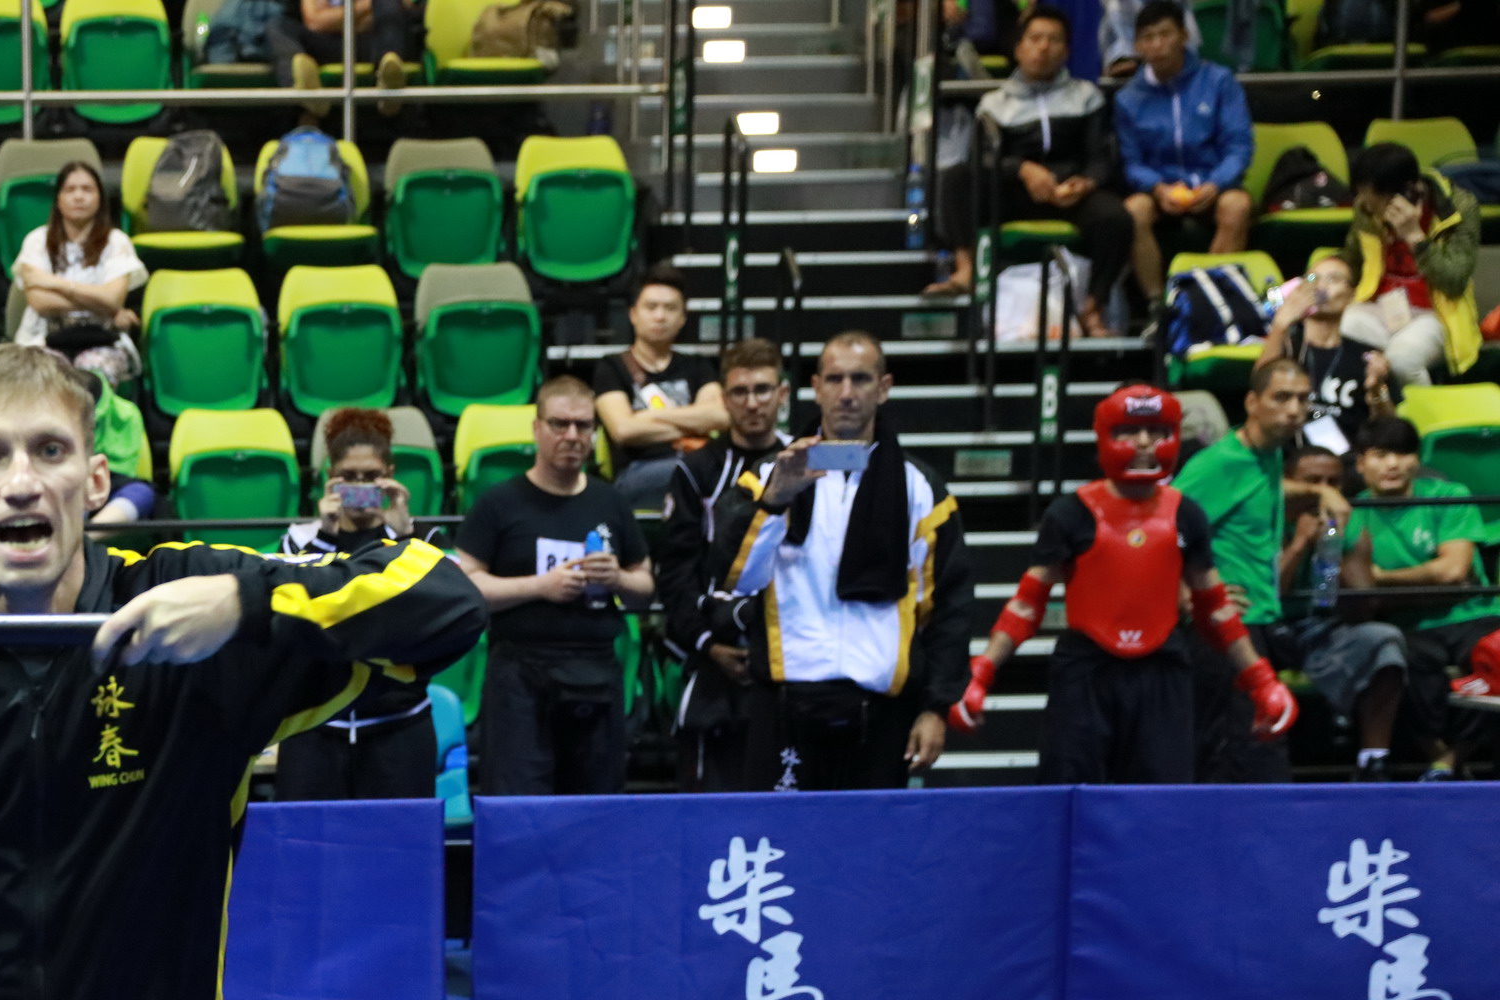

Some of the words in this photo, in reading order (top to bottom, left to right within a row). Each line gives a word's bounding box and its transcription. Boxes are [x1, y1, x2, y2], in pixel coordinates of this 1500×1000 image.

[726, 238, 739, 282] C
[975, 234, 991, 279] C
[1042, 374, 1058, 419] B
[88, 773, 118, 789] WING
